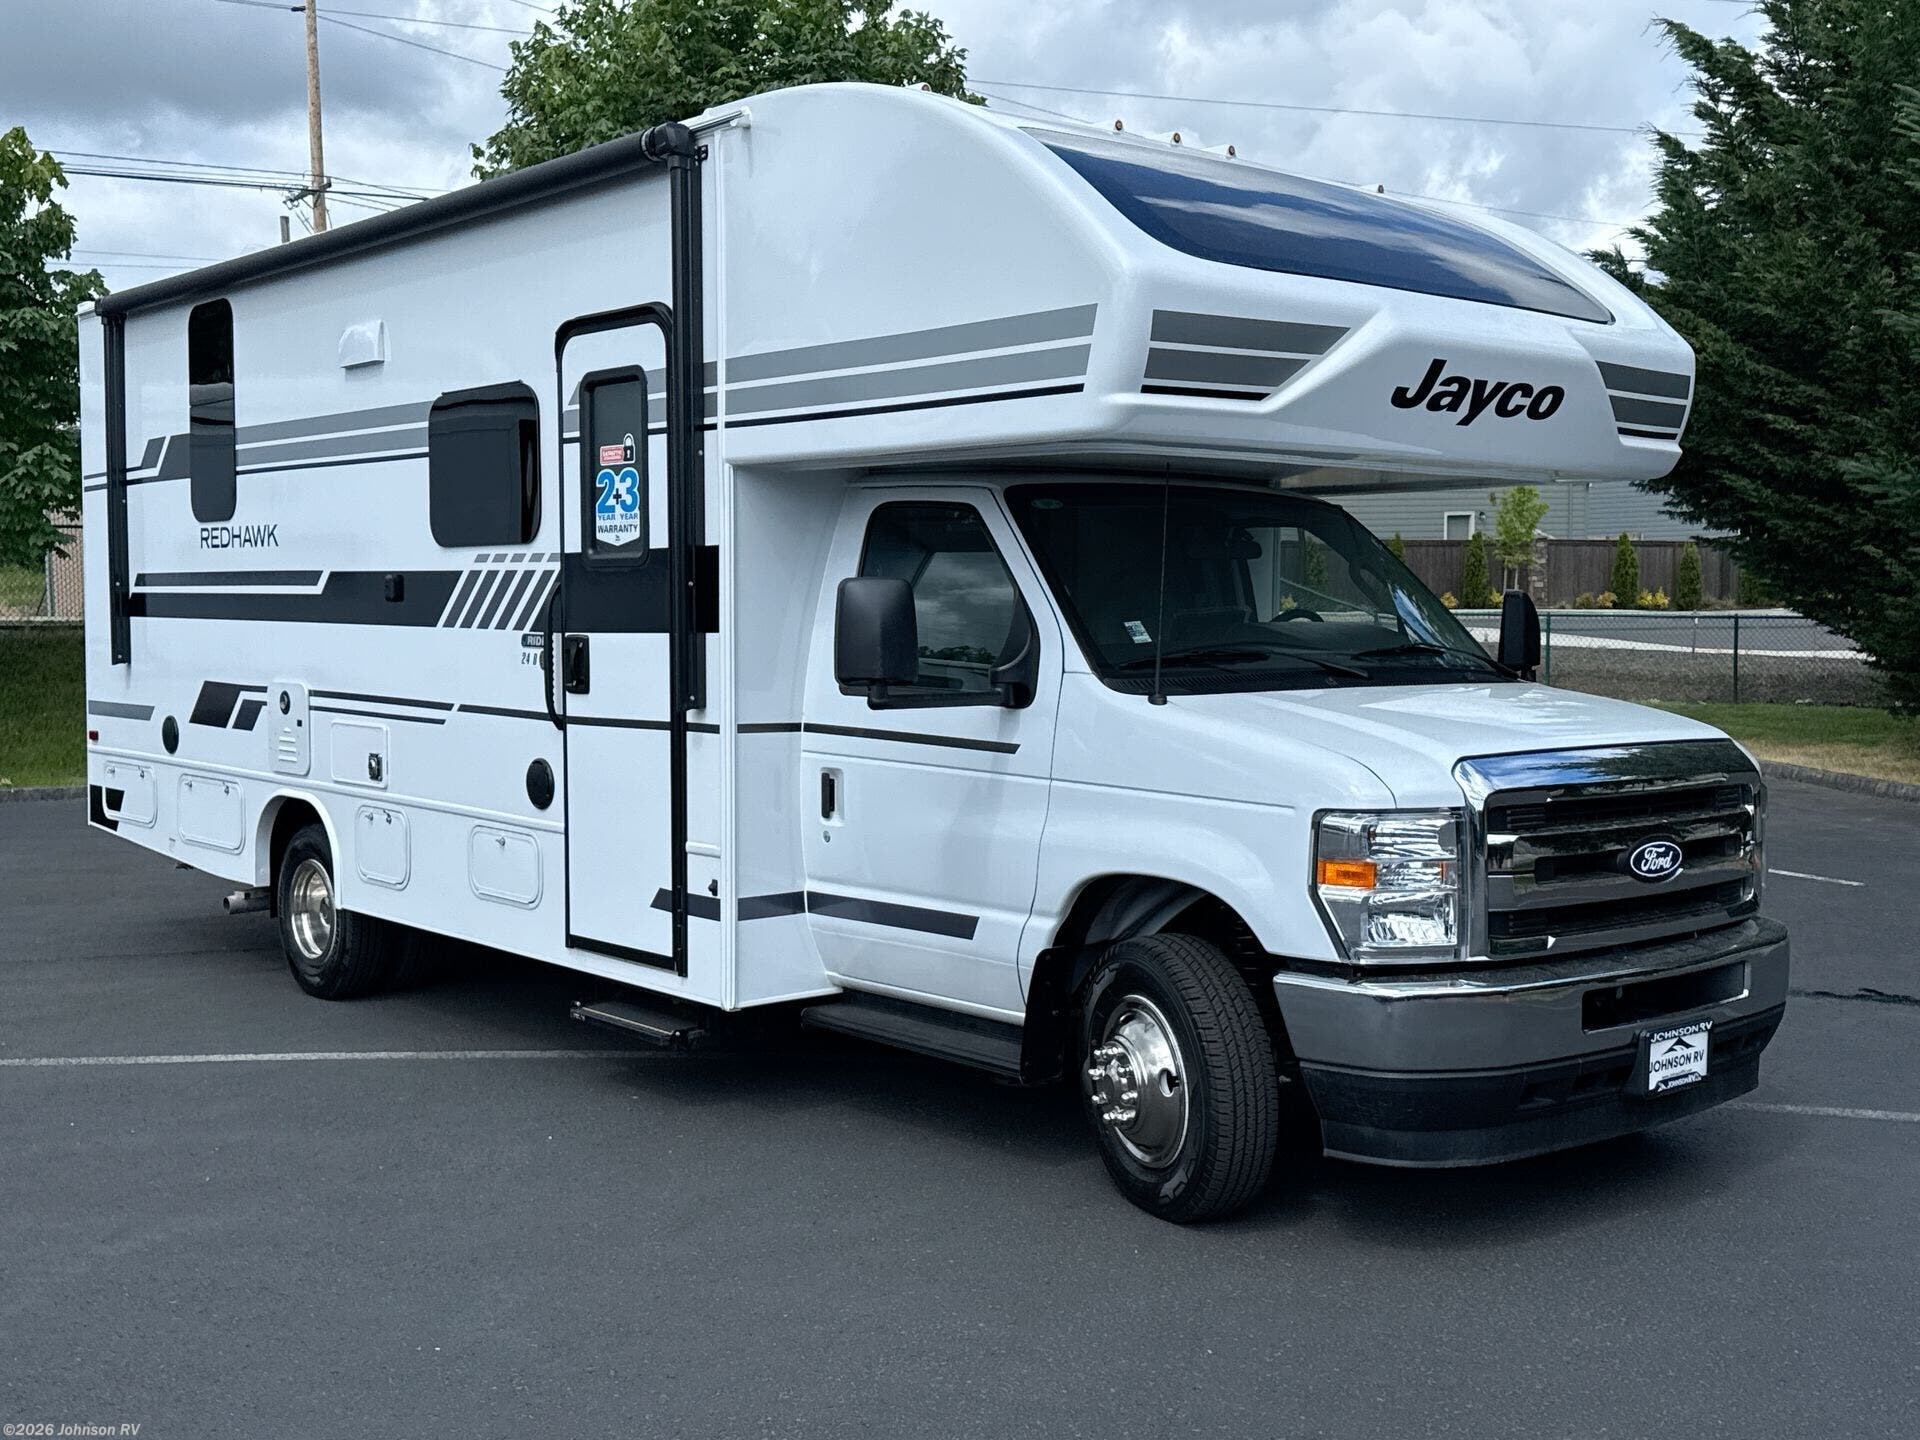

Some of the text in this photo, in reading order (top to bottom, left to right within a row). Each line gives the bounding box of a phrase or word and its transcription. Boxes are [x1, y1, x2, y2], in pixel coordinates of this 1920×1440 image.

[1390, 358, 1565, 426] Jayco
[200, 524, 279, 549] REDHAWK
[598, 524, 638, 534] WARRANTY
[1641, 846, 1674, 872] Ford
[1651, 1021, 1713, 1042] JOHNSON RV
[1649, 1049, 1705, 1073] JOHNSON RV
